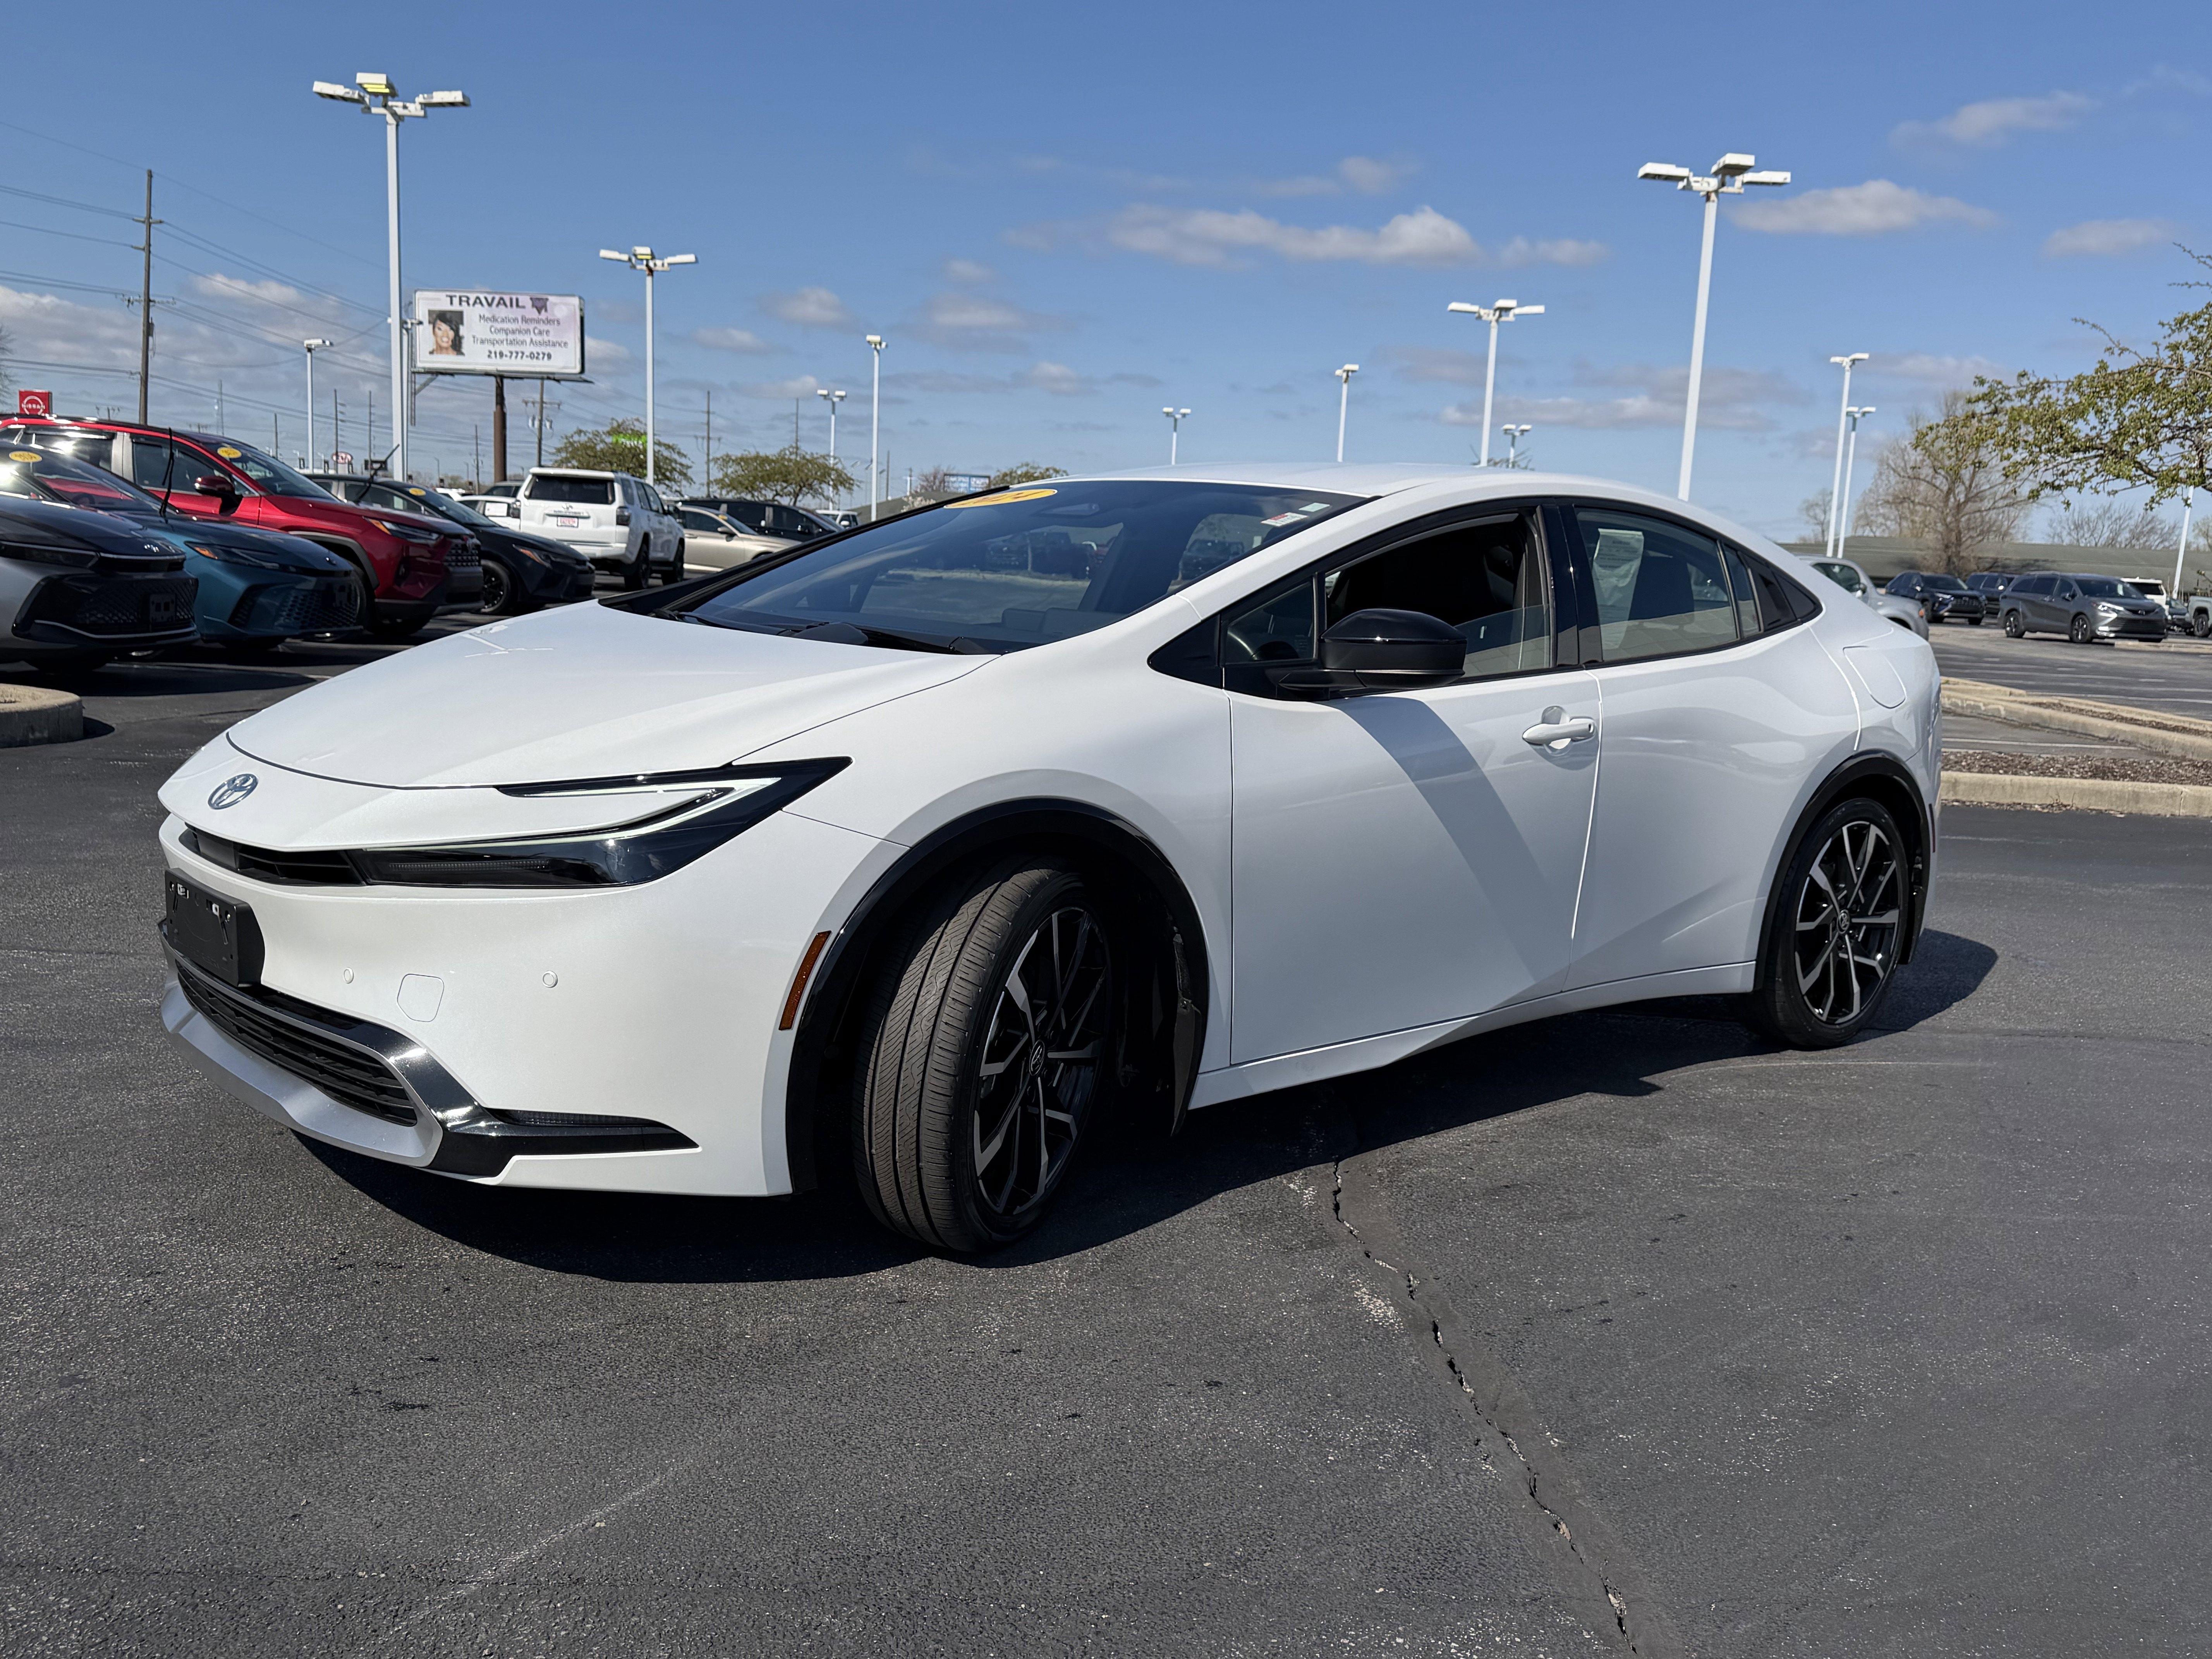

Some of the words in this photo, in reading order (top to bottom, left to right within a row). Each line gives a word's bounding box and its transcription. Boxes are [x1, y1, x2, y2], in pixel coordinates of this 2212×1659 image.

[446, 294, 526, 309] TRAVAIL
[479, 314, 519, 324] Medication
[521, 314, 561, 326] Reminders
[489, 325, 531, 336] Companion
[532, 326, 550, 337] Care
[472, 334, 527, 347] Transportation
[529, 337, 568, 348] Assistance
